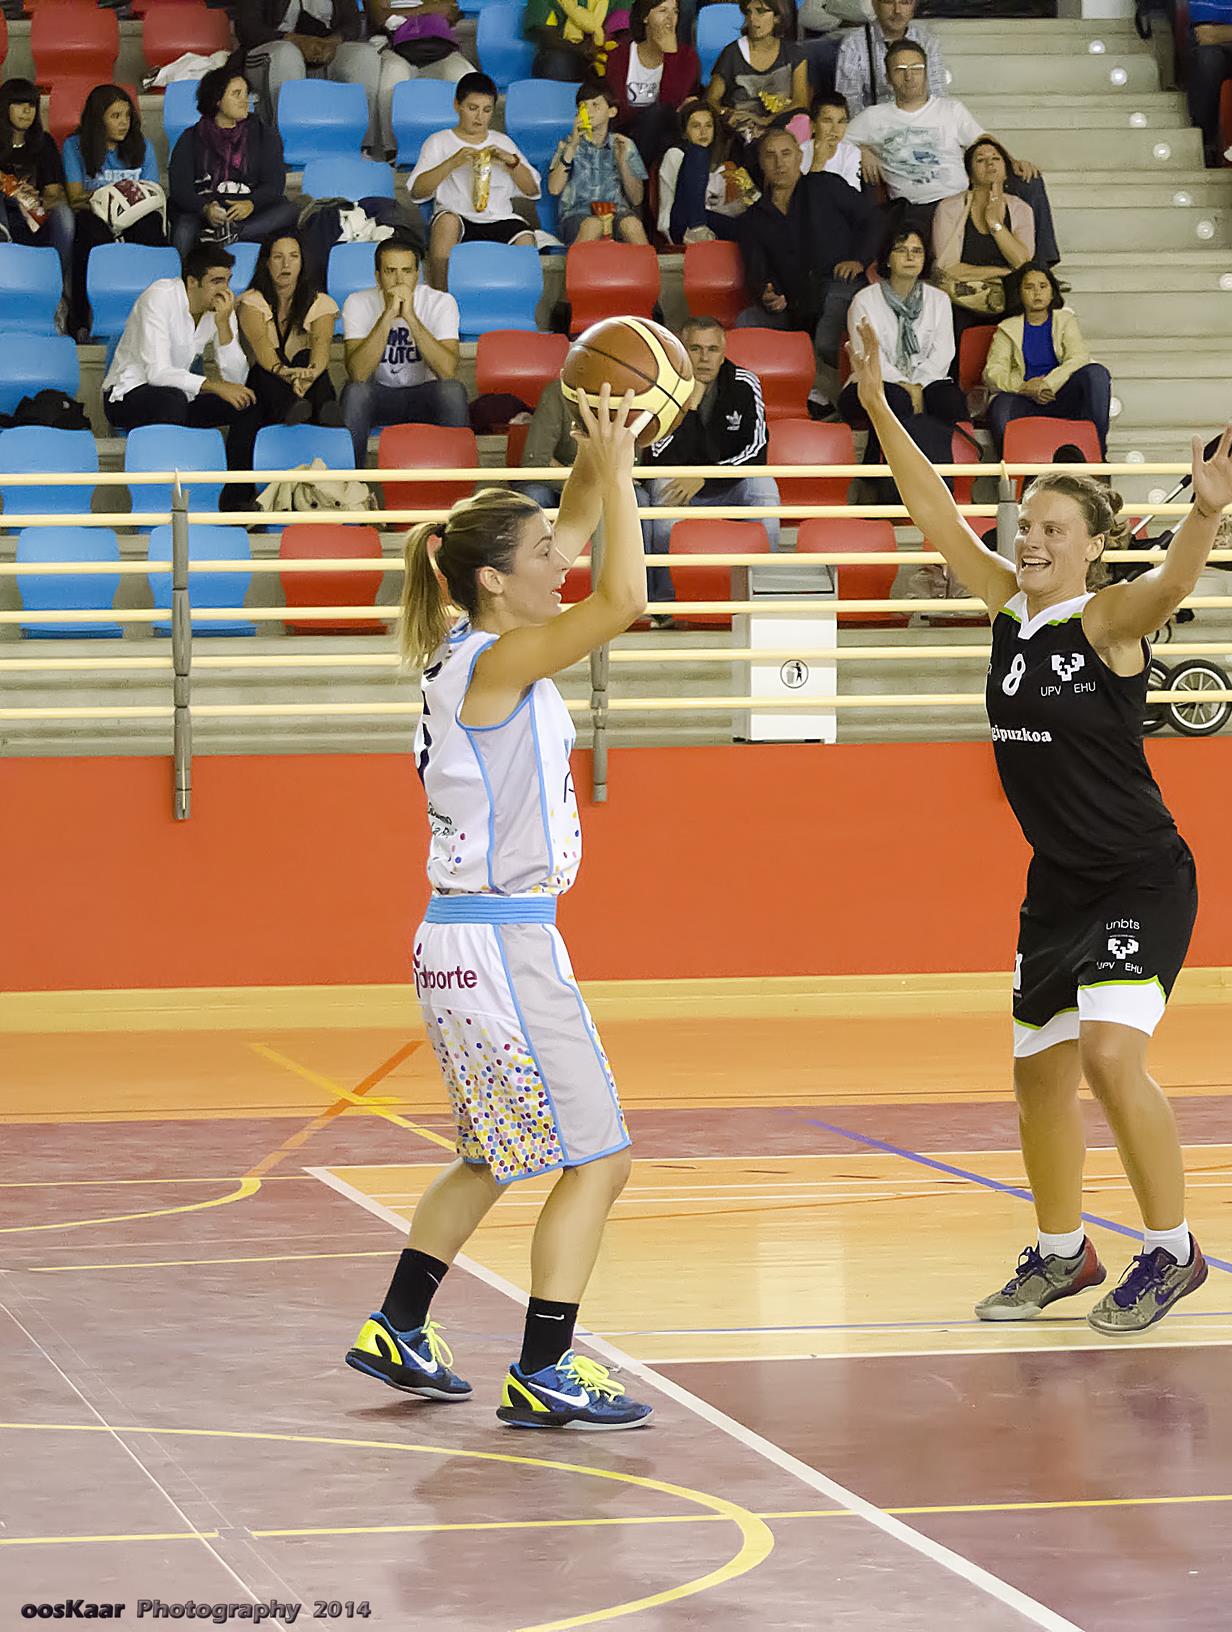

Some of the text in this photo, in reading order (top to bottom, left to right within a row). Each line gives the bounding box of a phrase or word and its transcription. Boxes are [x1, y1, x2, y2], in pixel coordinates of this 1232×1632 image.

[1002, 653, 1026, 696] 8
[1041, 681, 1096, 697] UPV EHU
[992, 725, 1053, 742] gipuzkoa
[1106, 918, 1140, 931] unbts
[1096, 961, 1143, 974] UPV EHU
